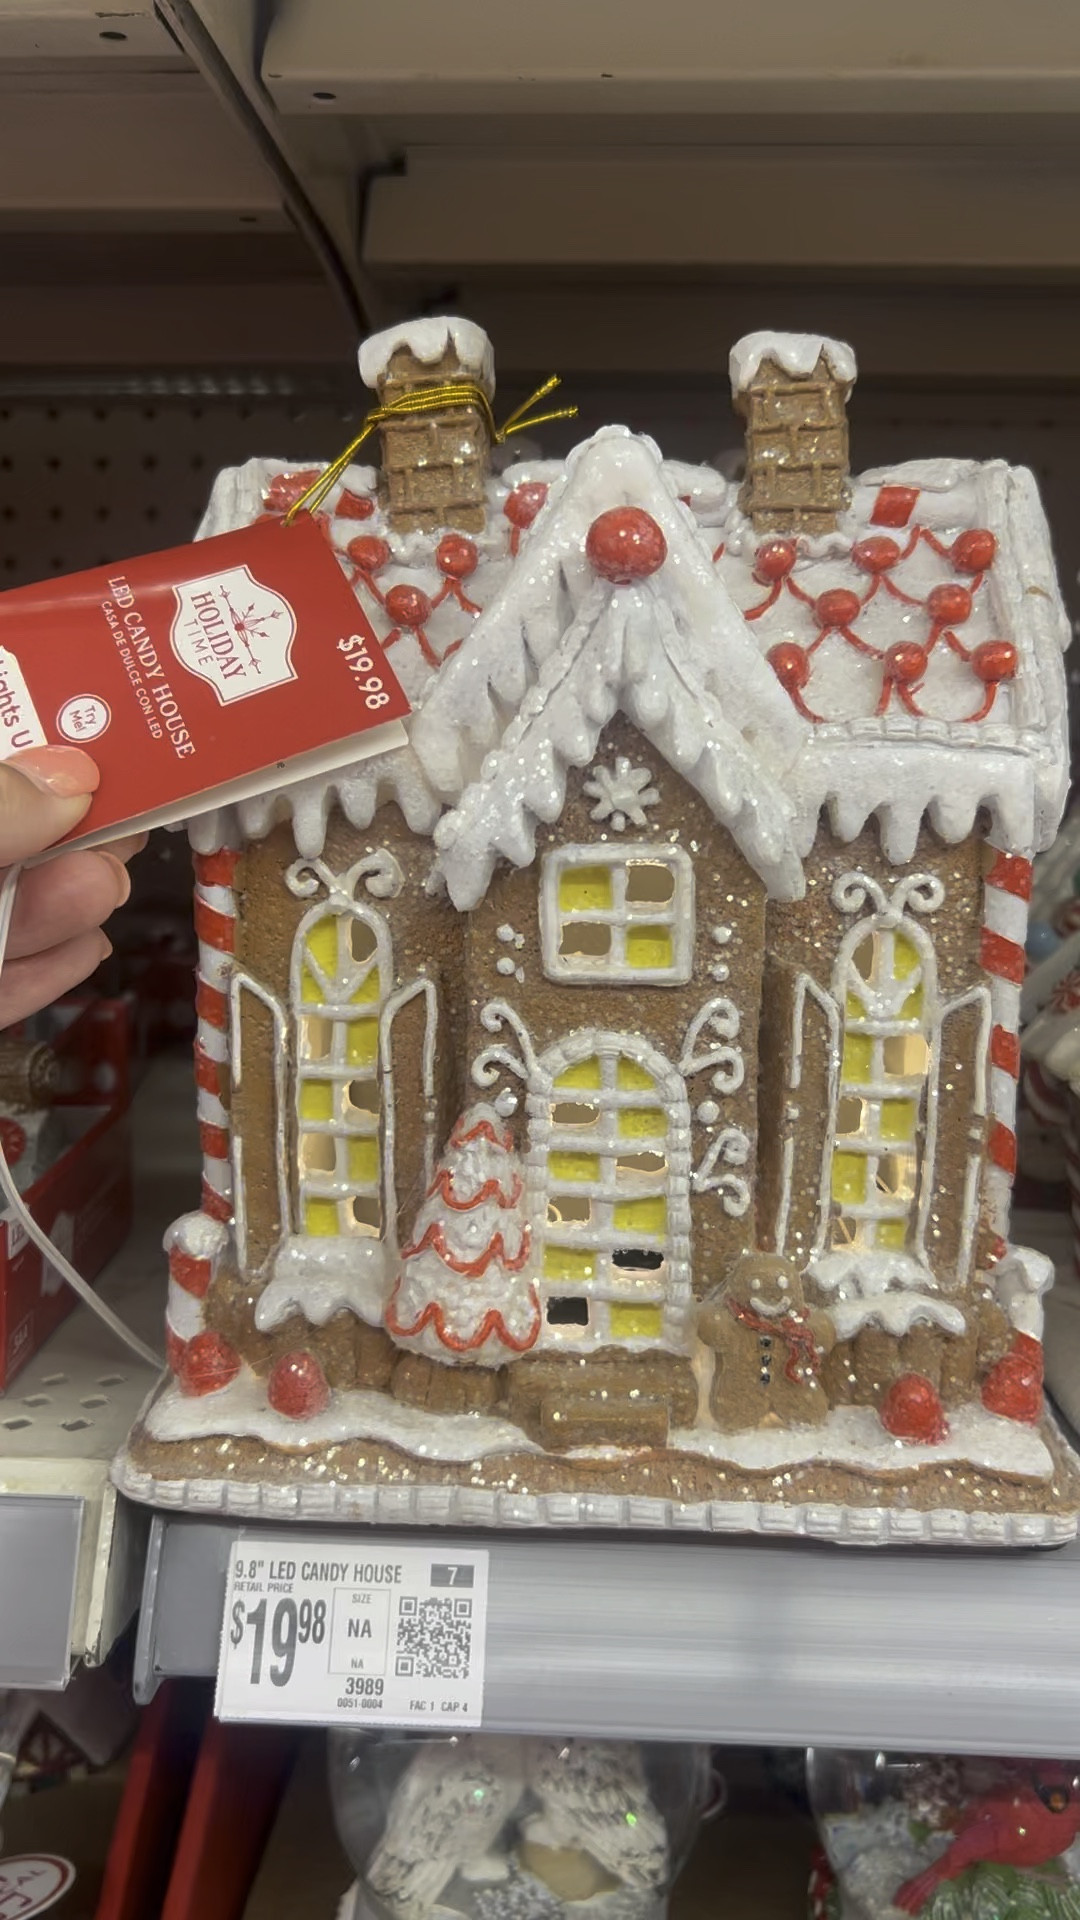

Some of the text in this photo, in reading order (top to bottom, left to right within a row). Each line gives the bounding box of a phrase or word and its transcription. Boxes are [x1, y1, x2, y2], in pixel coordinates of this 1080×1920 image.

[184, 619, 213, 666] TIME
[191, 591, 246, 679] HOLIDAY
[102, 601, 163, 739] CASA DE DULCE CON LED
[108, 576, 195, 759] LED CANDY HOUSE
[336, 635, 390, 709] $19.98
[69, 710, 87, 732] Me!
[84, 705, 96, 725] Try
[235, 1560, 402, 1584] 9.8" LED CANDY HOUSE
[447, 1566, 458, 1586] 7
[234, 1581, 294, 1593] RETAIL PRICE
[352, 1594, 372, 1604] SIZE
[347, 1618, 372, 1638] NA
[351, 1658, 364, 1669] NA
[345, 1677, 384, 1696] 3989
[410, 1700, 468, 1713] FAC 1 CAP 4
